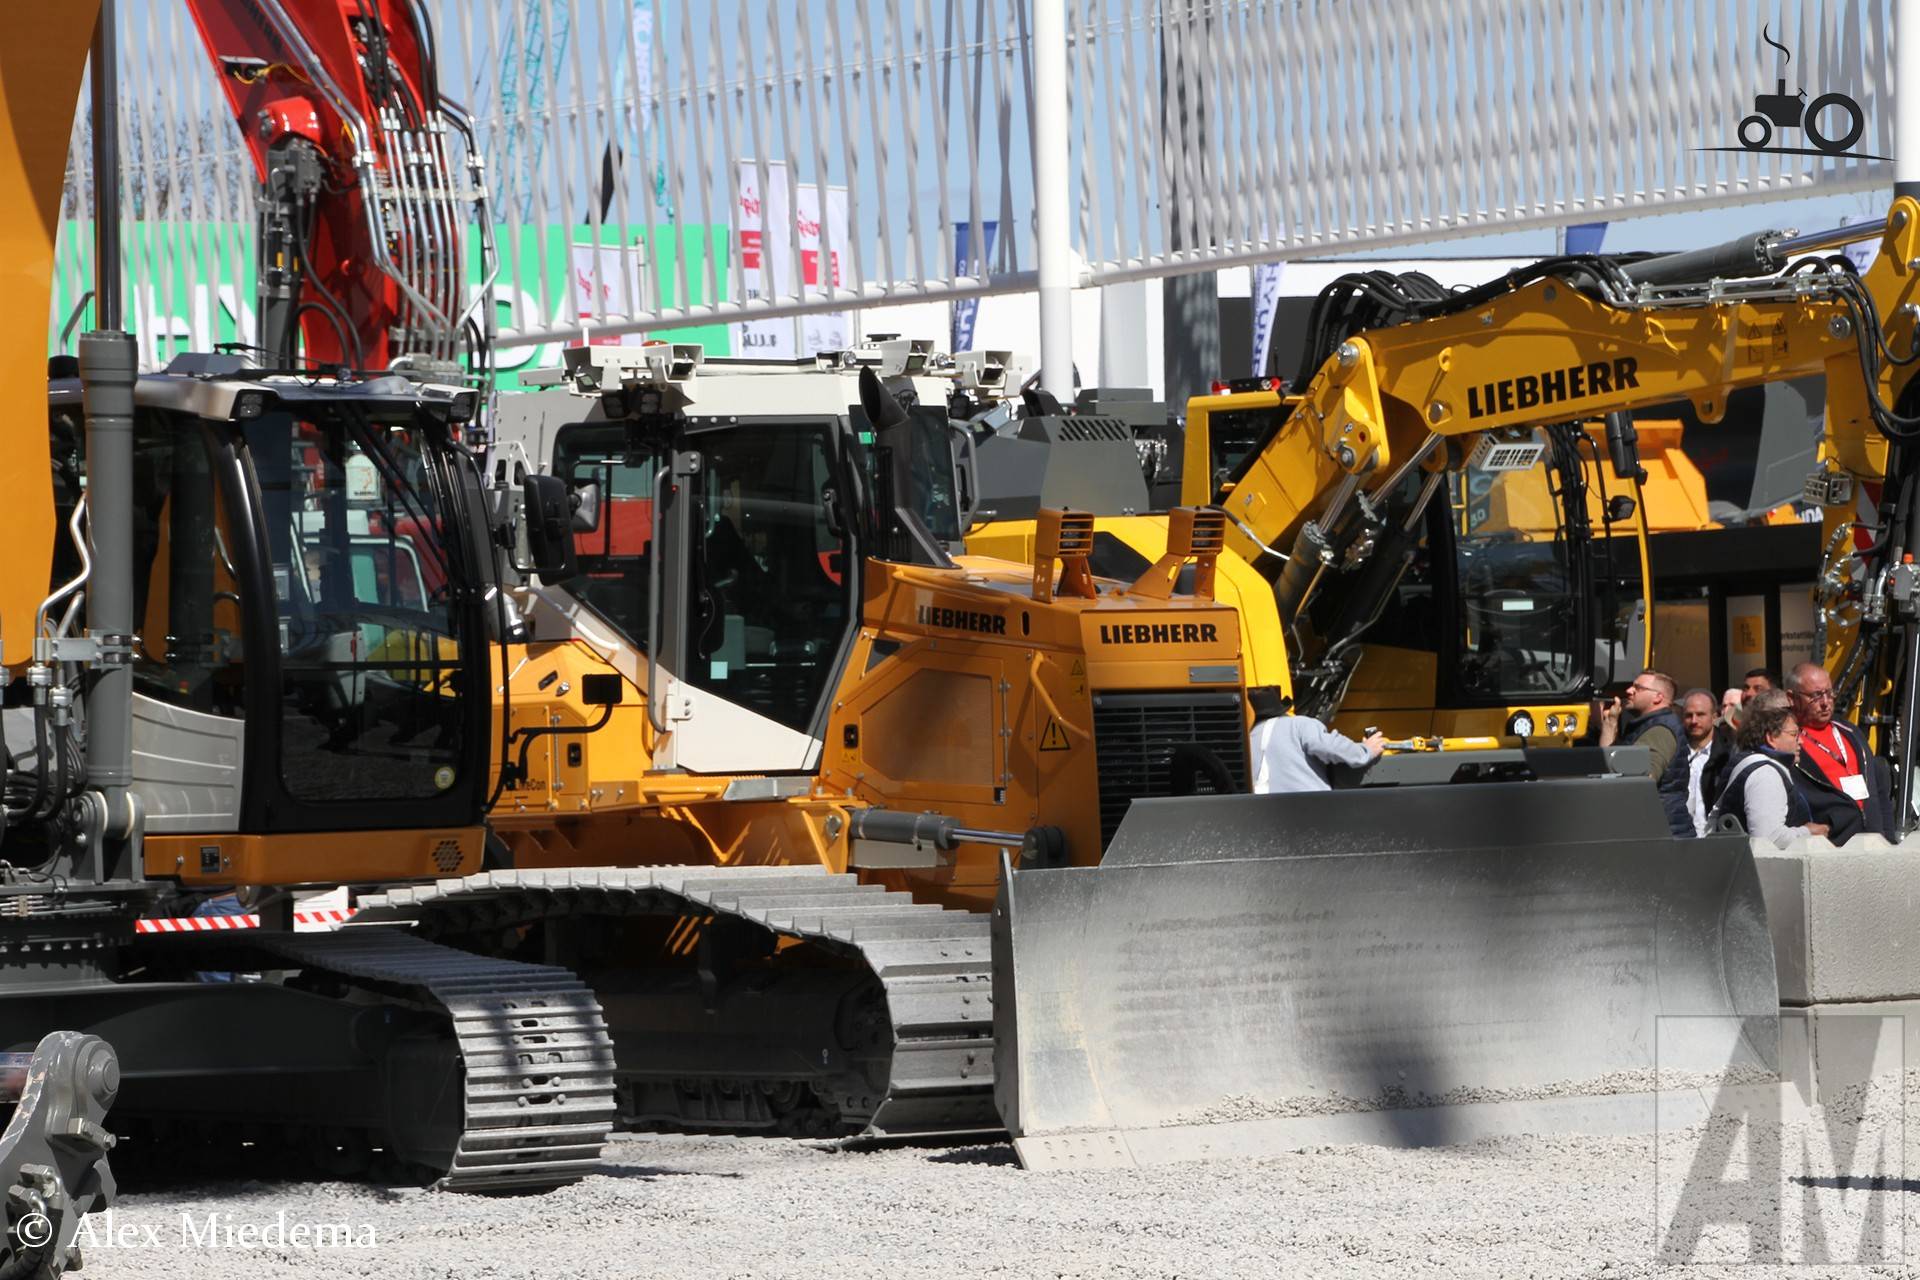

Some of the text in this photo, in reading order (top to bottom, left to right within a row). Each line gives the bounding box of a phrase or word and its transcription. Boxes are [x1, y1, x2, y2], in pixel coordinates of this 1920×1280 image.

[1467, 356, 1640, 419] LIEBHERR
[918, 605, 1006, 635] LIEBHERR
[1100, 623, 1218, 645] LIEBHERR
